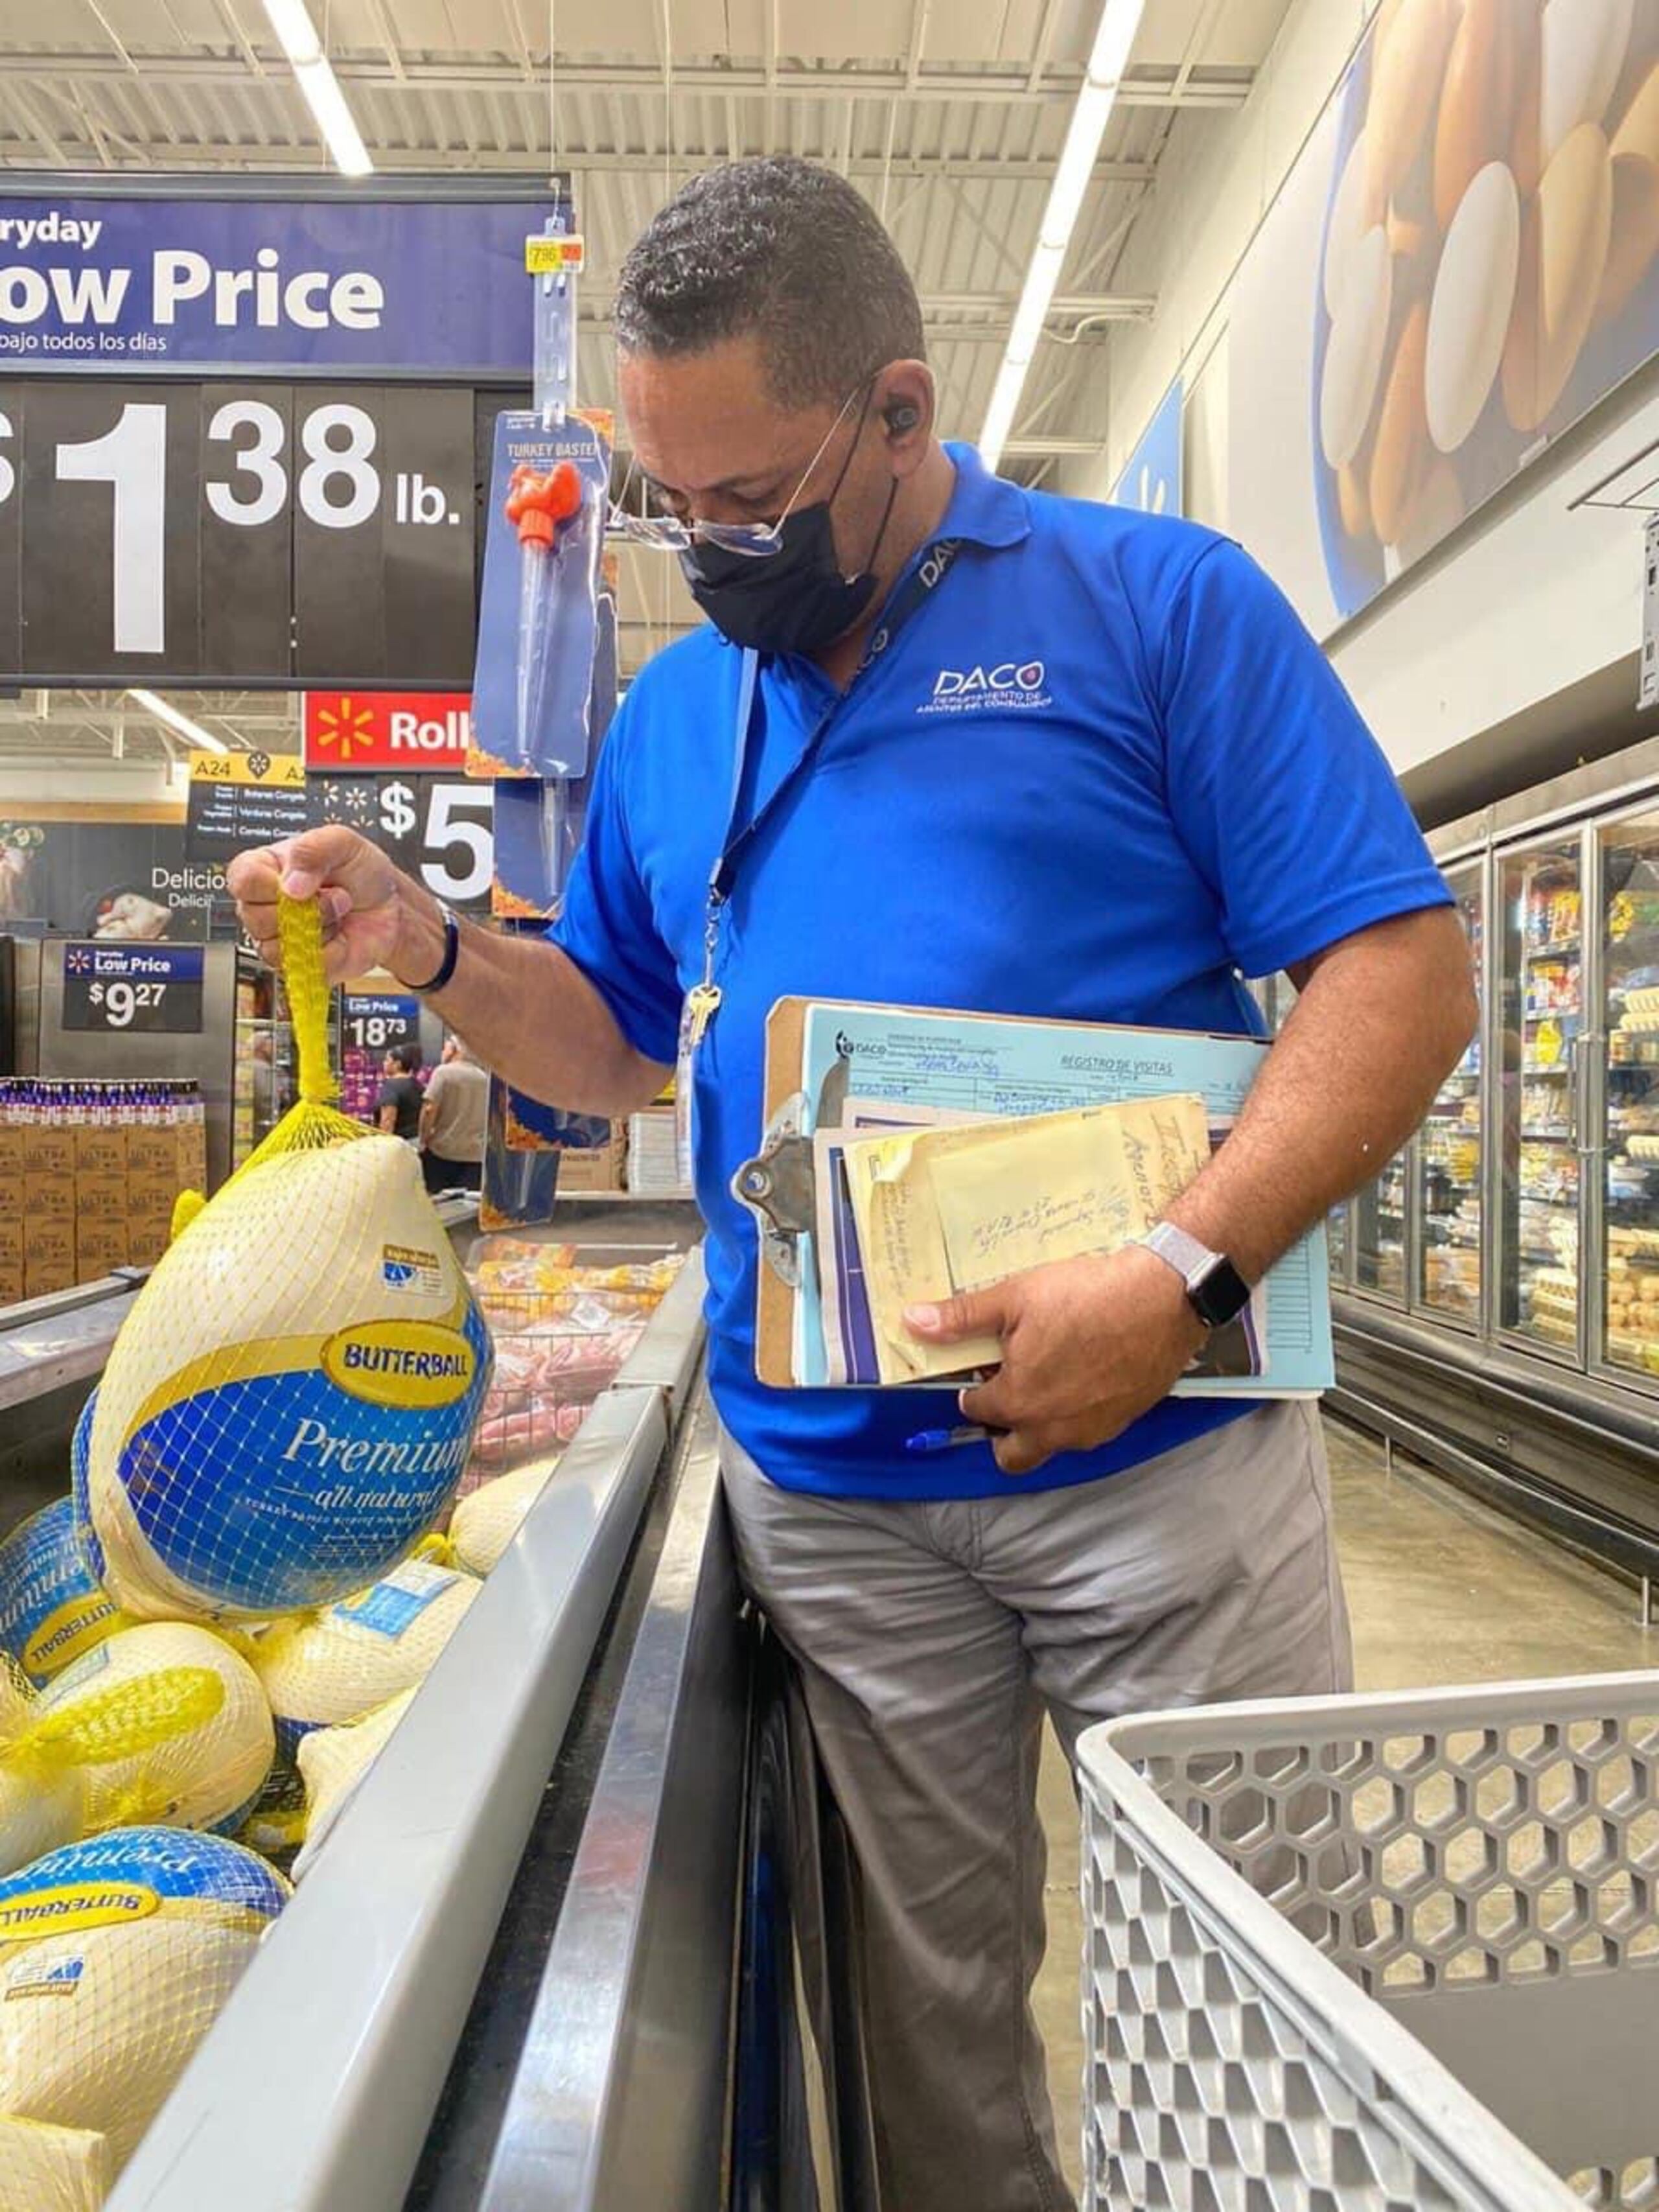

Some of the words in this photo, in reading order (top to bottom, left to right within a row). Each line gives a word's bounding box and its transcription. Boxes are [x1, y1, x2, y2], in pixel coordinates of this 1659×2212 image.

[153, 248, 386, 329] Price
[43, 332, 96, 351] todos
[99, 332, 126, 351] los
[129, 331, 167, 351] días
[396, 474, 460, 525] lb.
[933, 661, 1045, 695] DACO
[195, 760, 231, 775] A24
[152, 868, 229, 889] Delicio
[95, 957, 128, 971] Low
[132, 957, 171, 972] Price
[343, 1343, 467, 1379] BUTTERBALL
[315, 1484, 354, 1509] all
